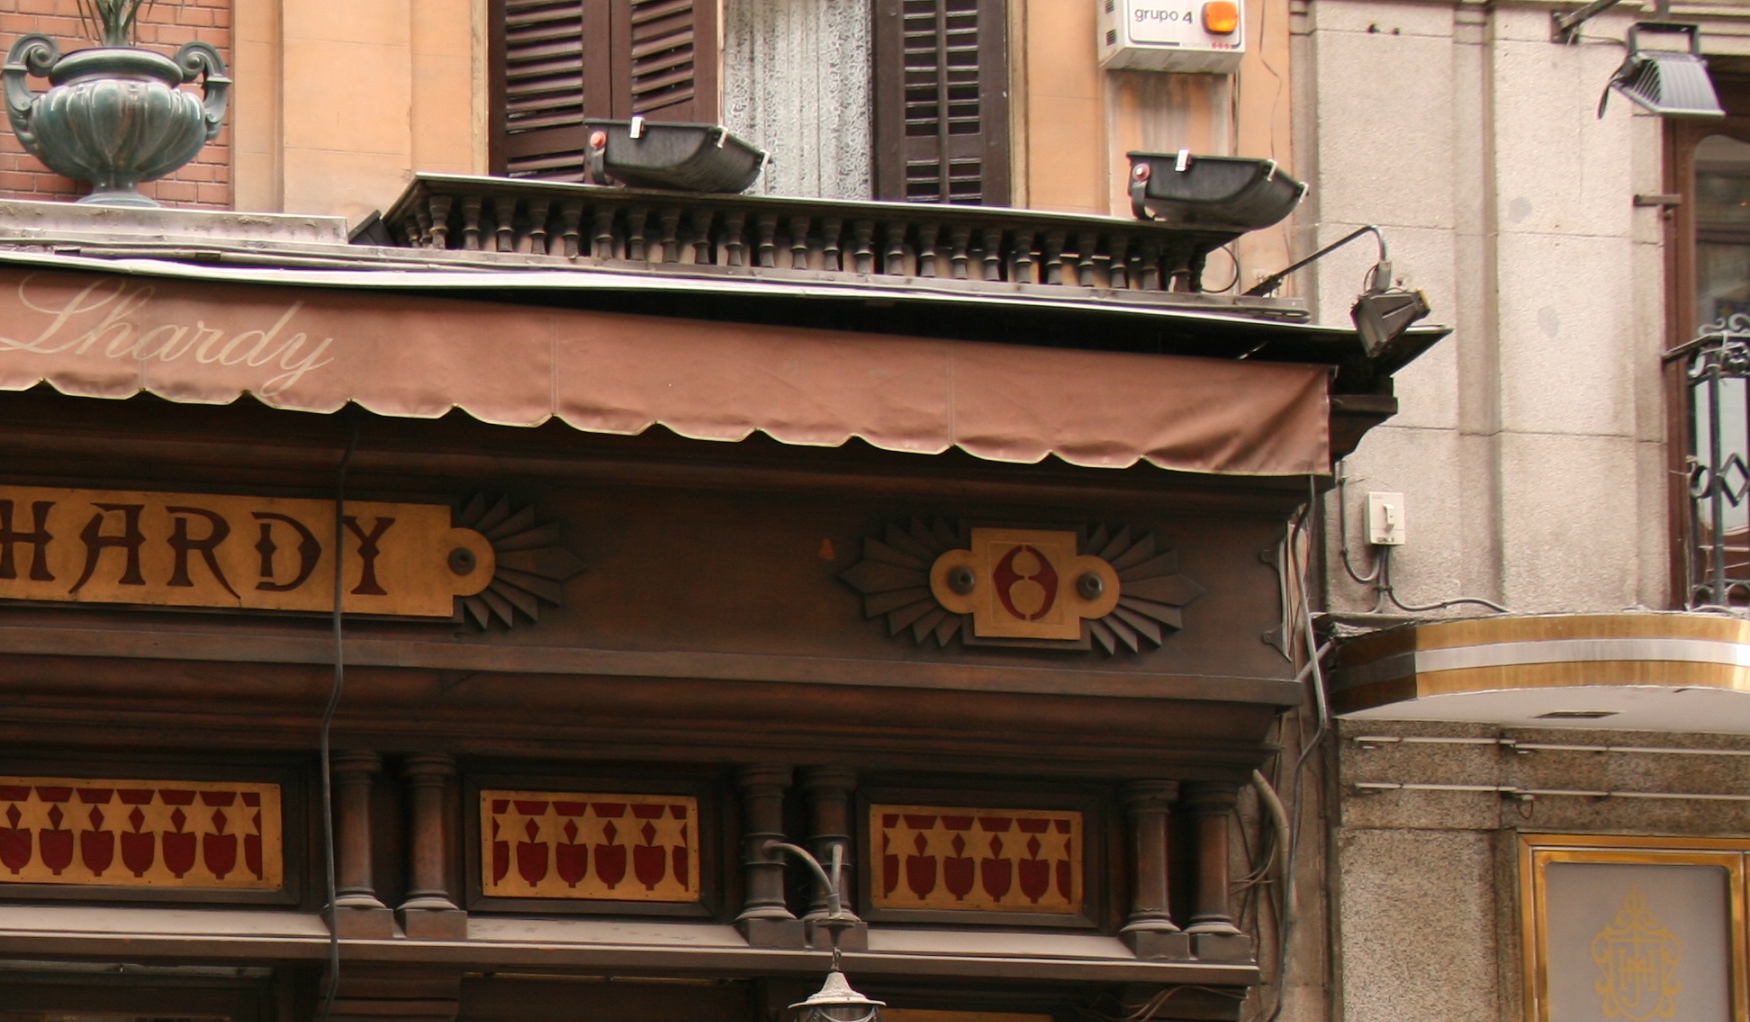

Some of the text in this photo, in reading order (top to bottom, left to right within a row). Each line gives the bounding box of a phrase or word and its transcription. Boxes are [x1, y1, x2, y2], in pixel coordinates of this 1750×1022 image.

[1134, 8, 1193, 25] grupo 4
[993, 545, 1059, 622] 8
